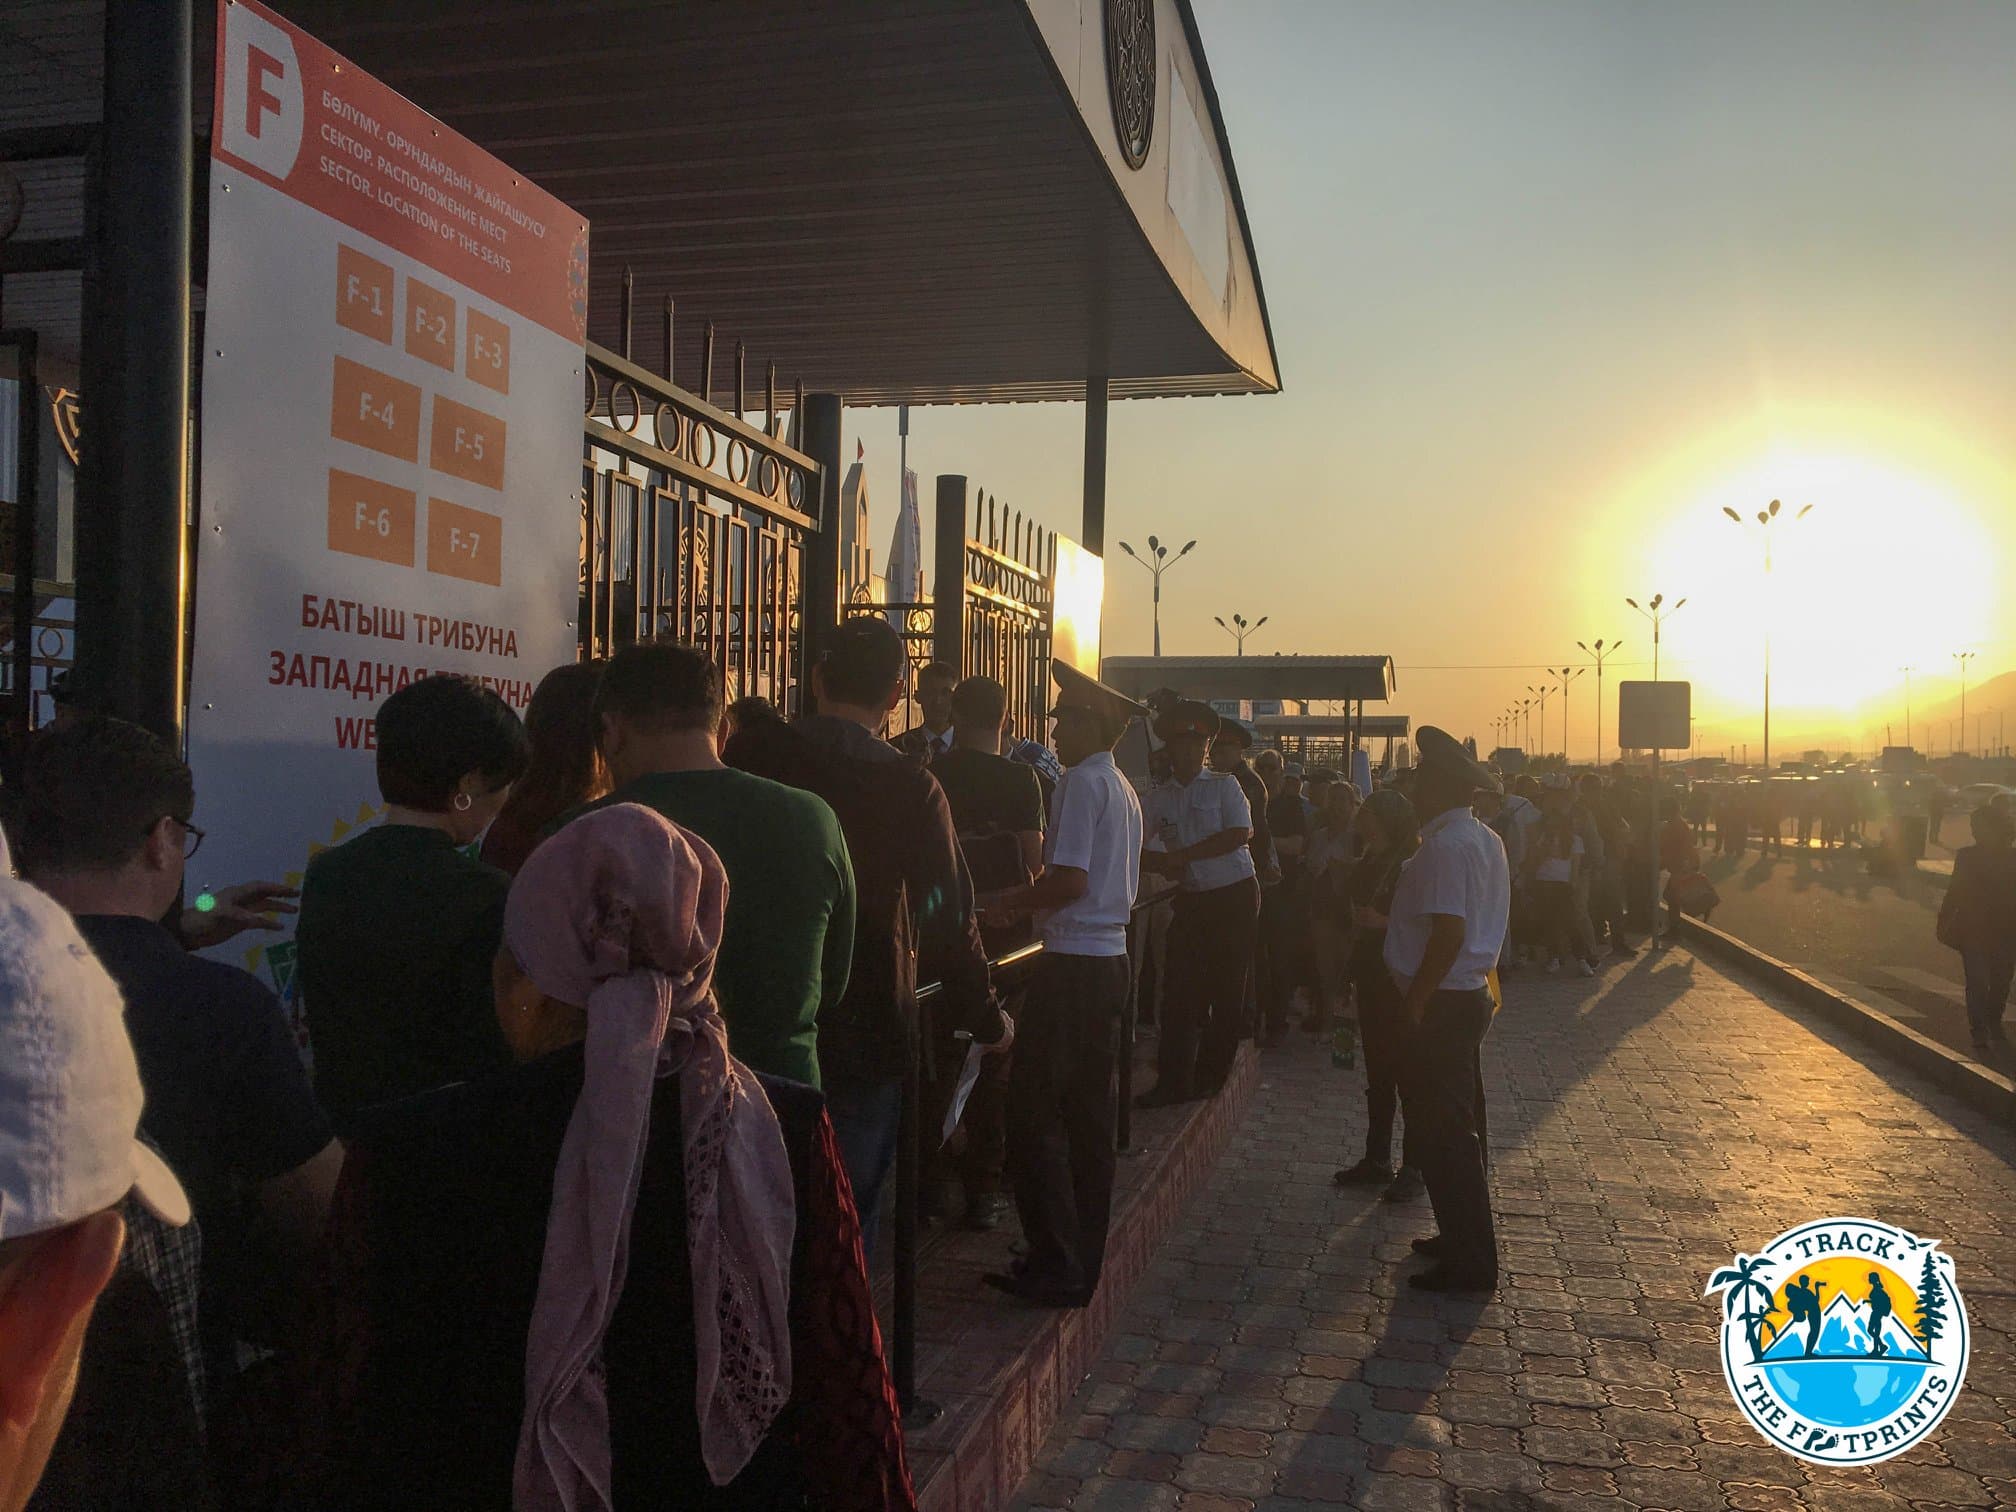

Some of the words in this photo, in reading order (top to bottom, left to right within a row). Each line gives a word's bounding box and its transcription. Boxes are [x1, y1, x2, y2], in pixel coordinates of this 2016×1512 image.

[245, 43, 284, 139] F
[321, 123, 374, 167] СЕКТОР.
[377, 155, 477, 226] РАСПОЛОЖЕНИЕ
[479, 215, 508, 243] МЕСТ
[387, 131, 472, 194] ОРУНДАРДЫН
[320, 155, 374, 198] SECTOR.
[378, 186, 438, 232] LOCATION
[440, 223, 456, 241] OF
[457, 232, 478, 256] THE
[481, 246, 511, 273] SEATS
[346, 274, 384, 317] F-1
[414, 306, 447, 345] F-2
[474, 333, 503, 369] F-3
[359, 392, 395, 430] F-4
[454, 426, 484, 461] F-5
[355, 501, 390, 537] F-6
[450, 527, 481, 559] F-7
[302, 593, 405, 642] БАТЫШ
[413, 612, 519, 659] ТРИБУНА
